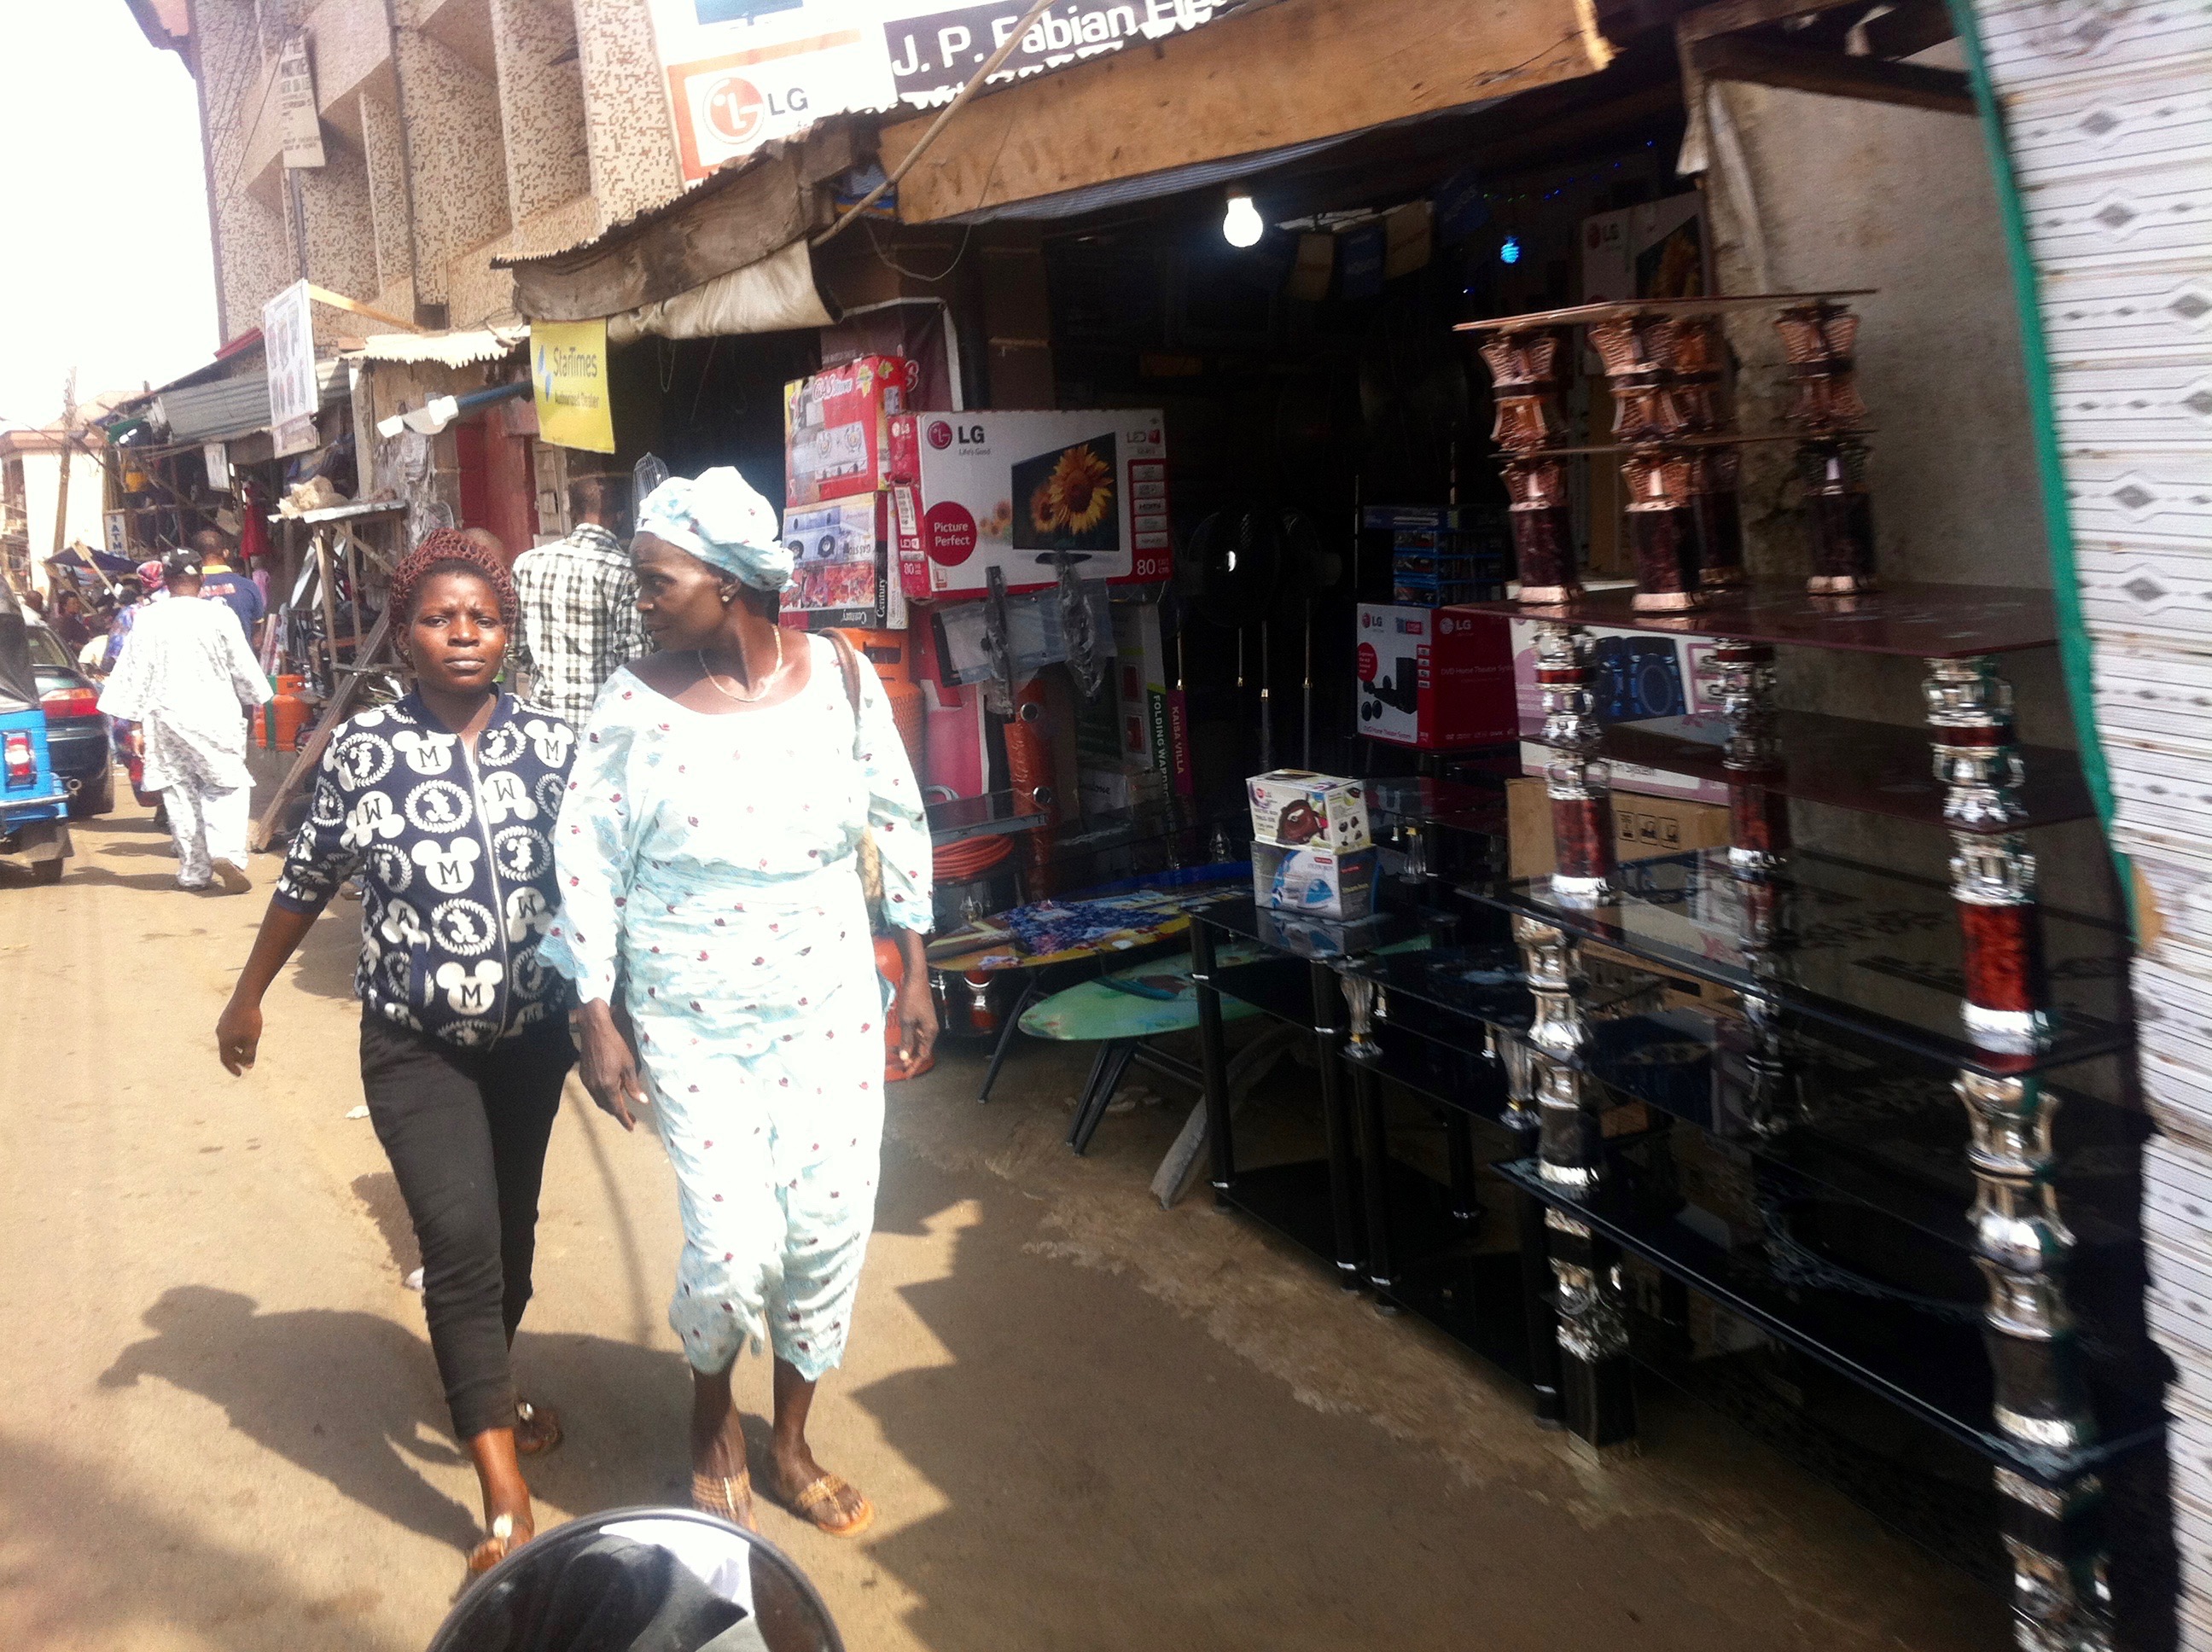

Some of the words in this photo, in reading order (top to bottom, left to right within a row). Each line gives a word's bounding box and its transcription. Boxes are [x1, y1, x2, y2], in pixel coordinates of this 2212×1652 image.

[893, 35, 930, 76] J.
[938, 26, 984, 69] P.
[992, 5, 1138, 56] Fabian
[767, 87, 809, 116] LG
[553, 346, 597, 377] StarTimes
[958, 425, 985, 444] LG
[934, 521, 969, 532] Picture
[934, 534, 971, 546] Perfect
[1137, 559, 1155, 575] 80
[876, 579, 888, 618] Century
[1456, 620, 1471, 631] LG
[1153, 694, 1166, 747] FOLDING
[417, 745, 442, 768] M
[544, 738, 560, 761] M
[437, 860, 464, 885] M
[461, 984, 483, 1007] M
